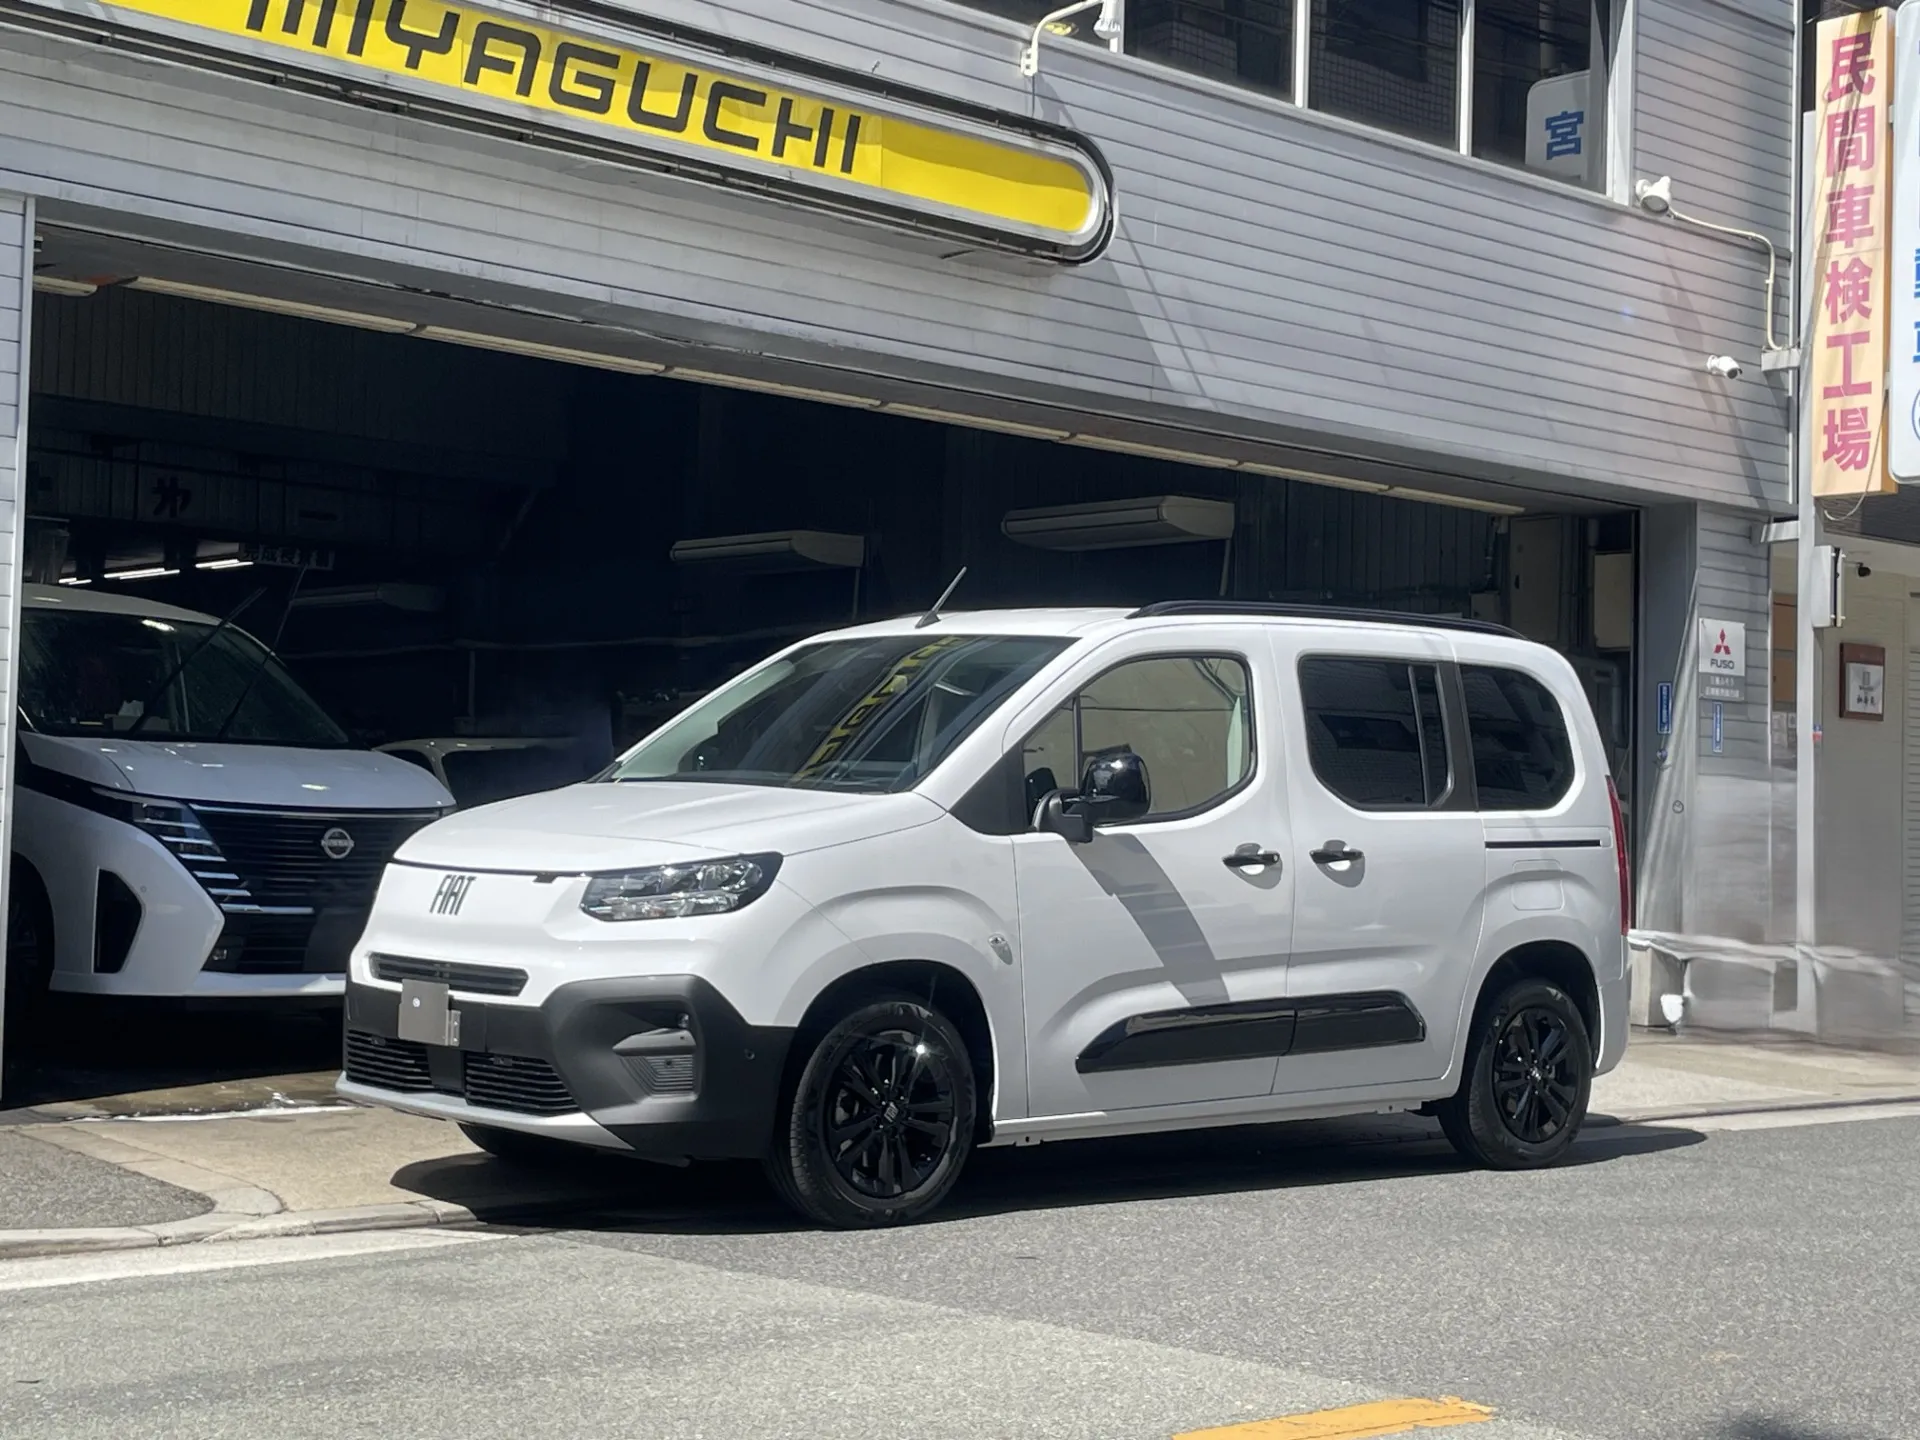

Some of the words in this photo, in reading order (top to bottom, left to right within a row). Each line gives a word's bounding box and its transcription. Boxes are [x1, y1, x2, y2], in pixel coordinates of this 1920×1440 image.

[1545, 111, 1584, 160] 宮
[1822, 32, 1876, 472] 民間車検工場
[1710, 658, 1735, 669] FUSO
[429, 874, 477, 916] FIAT
